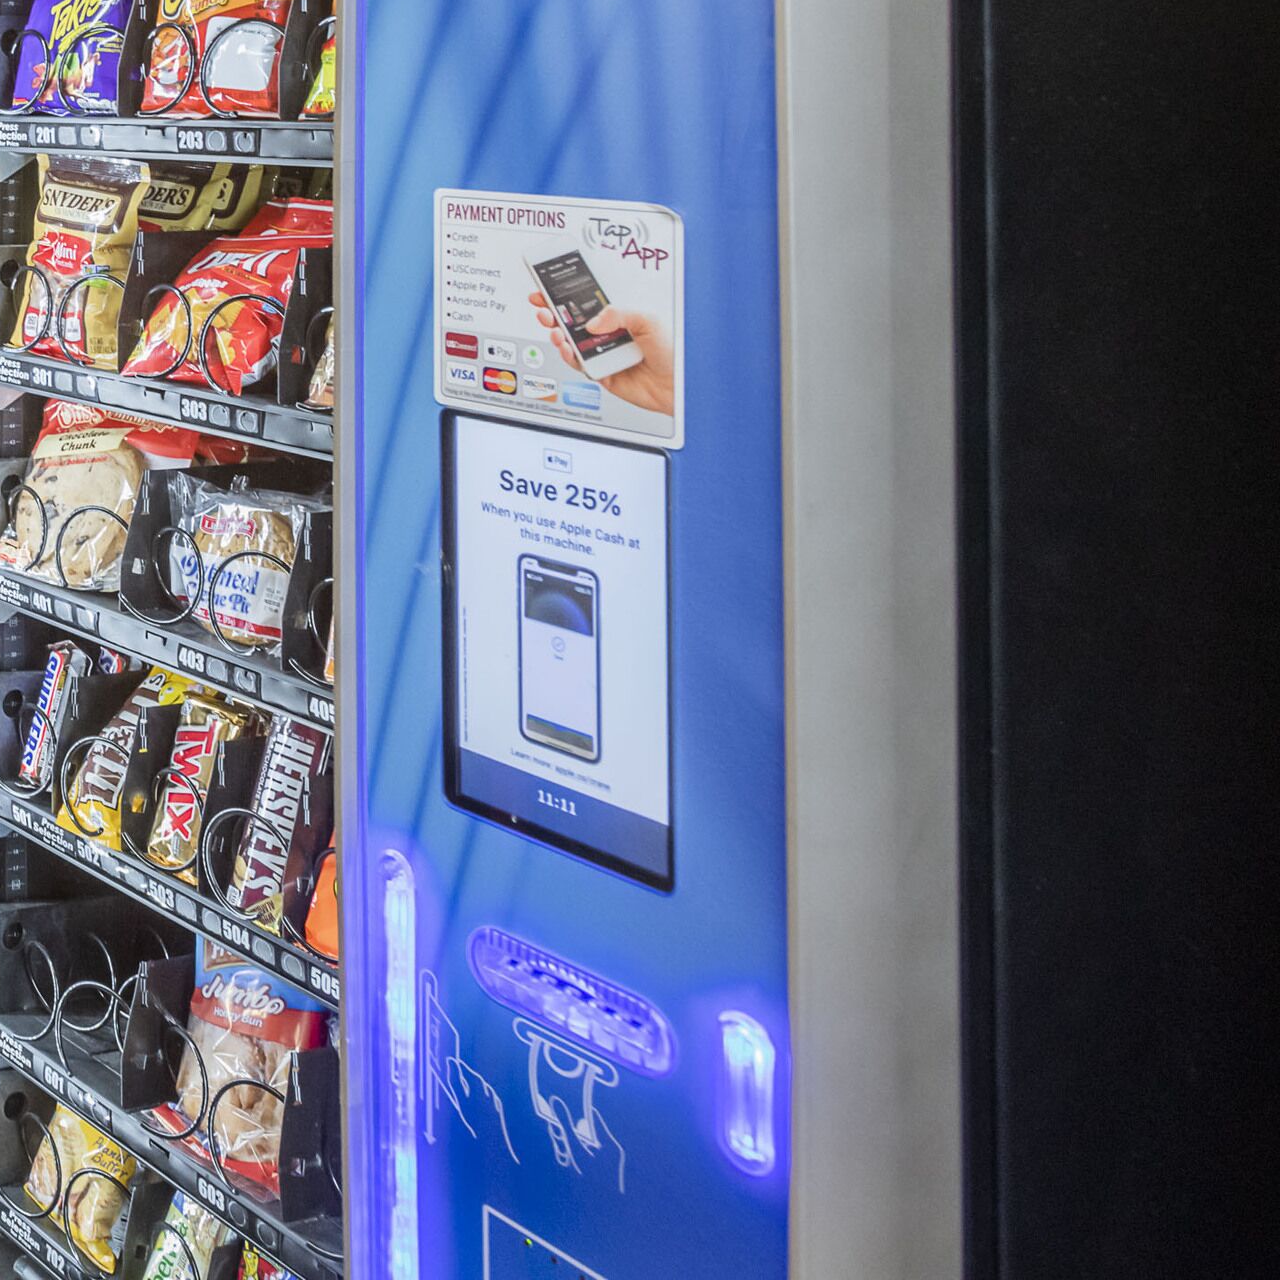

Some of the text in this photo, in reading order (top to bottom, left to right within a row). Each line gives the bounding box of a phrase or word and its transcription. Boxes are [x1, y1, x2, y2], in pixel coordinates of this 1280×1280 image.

[36, 126, 56, 145] 201
[178, 130, 204, 149] 203
[447, 203, 566, 229] PAYMENT OPTIONS
[452, 232, 479, 243] Credit
[588, 217, 632, 247] Tap
[452, 247, 476, 259] Debit
[621, 237, 669, 271] App
[452, 263, 502, 278] USConnect
[452, 280, 496, 295] Apple Pay
[452, 296, 506, 312] Android Pay
[452, 311, 474, 322] Cash
[0, 356, 21, 368] Press
[496, 345, 513, 360] Pay
[32, 367, 53, 387] 301
[450, 367, 476, 382] VISA
[181, 398, 208, 420] 303
[60, 440, 97, 452] Chunk
[499, 469, 621, 516] Save 25%
[481, 501, 641, 550] When you use Apple Cash at
[520, 527, 595, 556] this machine.
[32, 592, 53, 614] 401
[178, 647, 205, 673] 403
[163, 718, 219, 841] TWIX
[244, 733, 316, 897] HERSHEY'S
[537, 789, 578, 816] 11:11
[11, 804, 33, 830] 501
[41, 817, 65, 837] Press
[33, 822, 74, 852] Selection
[76, 839, 101, 867] 502
[149, 879, 175, 908] 503
[222, 918, 250, 951] 504
[202, 973, 286, 1015] Jumbo
[310, 966, 340, 1001] 505
[241, 1012, 263, 1028] Bun
[0, 1031, 23, 1051] Press
[44, 1065, 65, 1095] 601
[91, 1153, 129, 1179] Butter
[197, 1178, 225, 1212] 603
[0, 1211, 41, 1251] Selection
[9, 1210, 32, 1232] Press
[45, 1243, 65, 1275] 702
